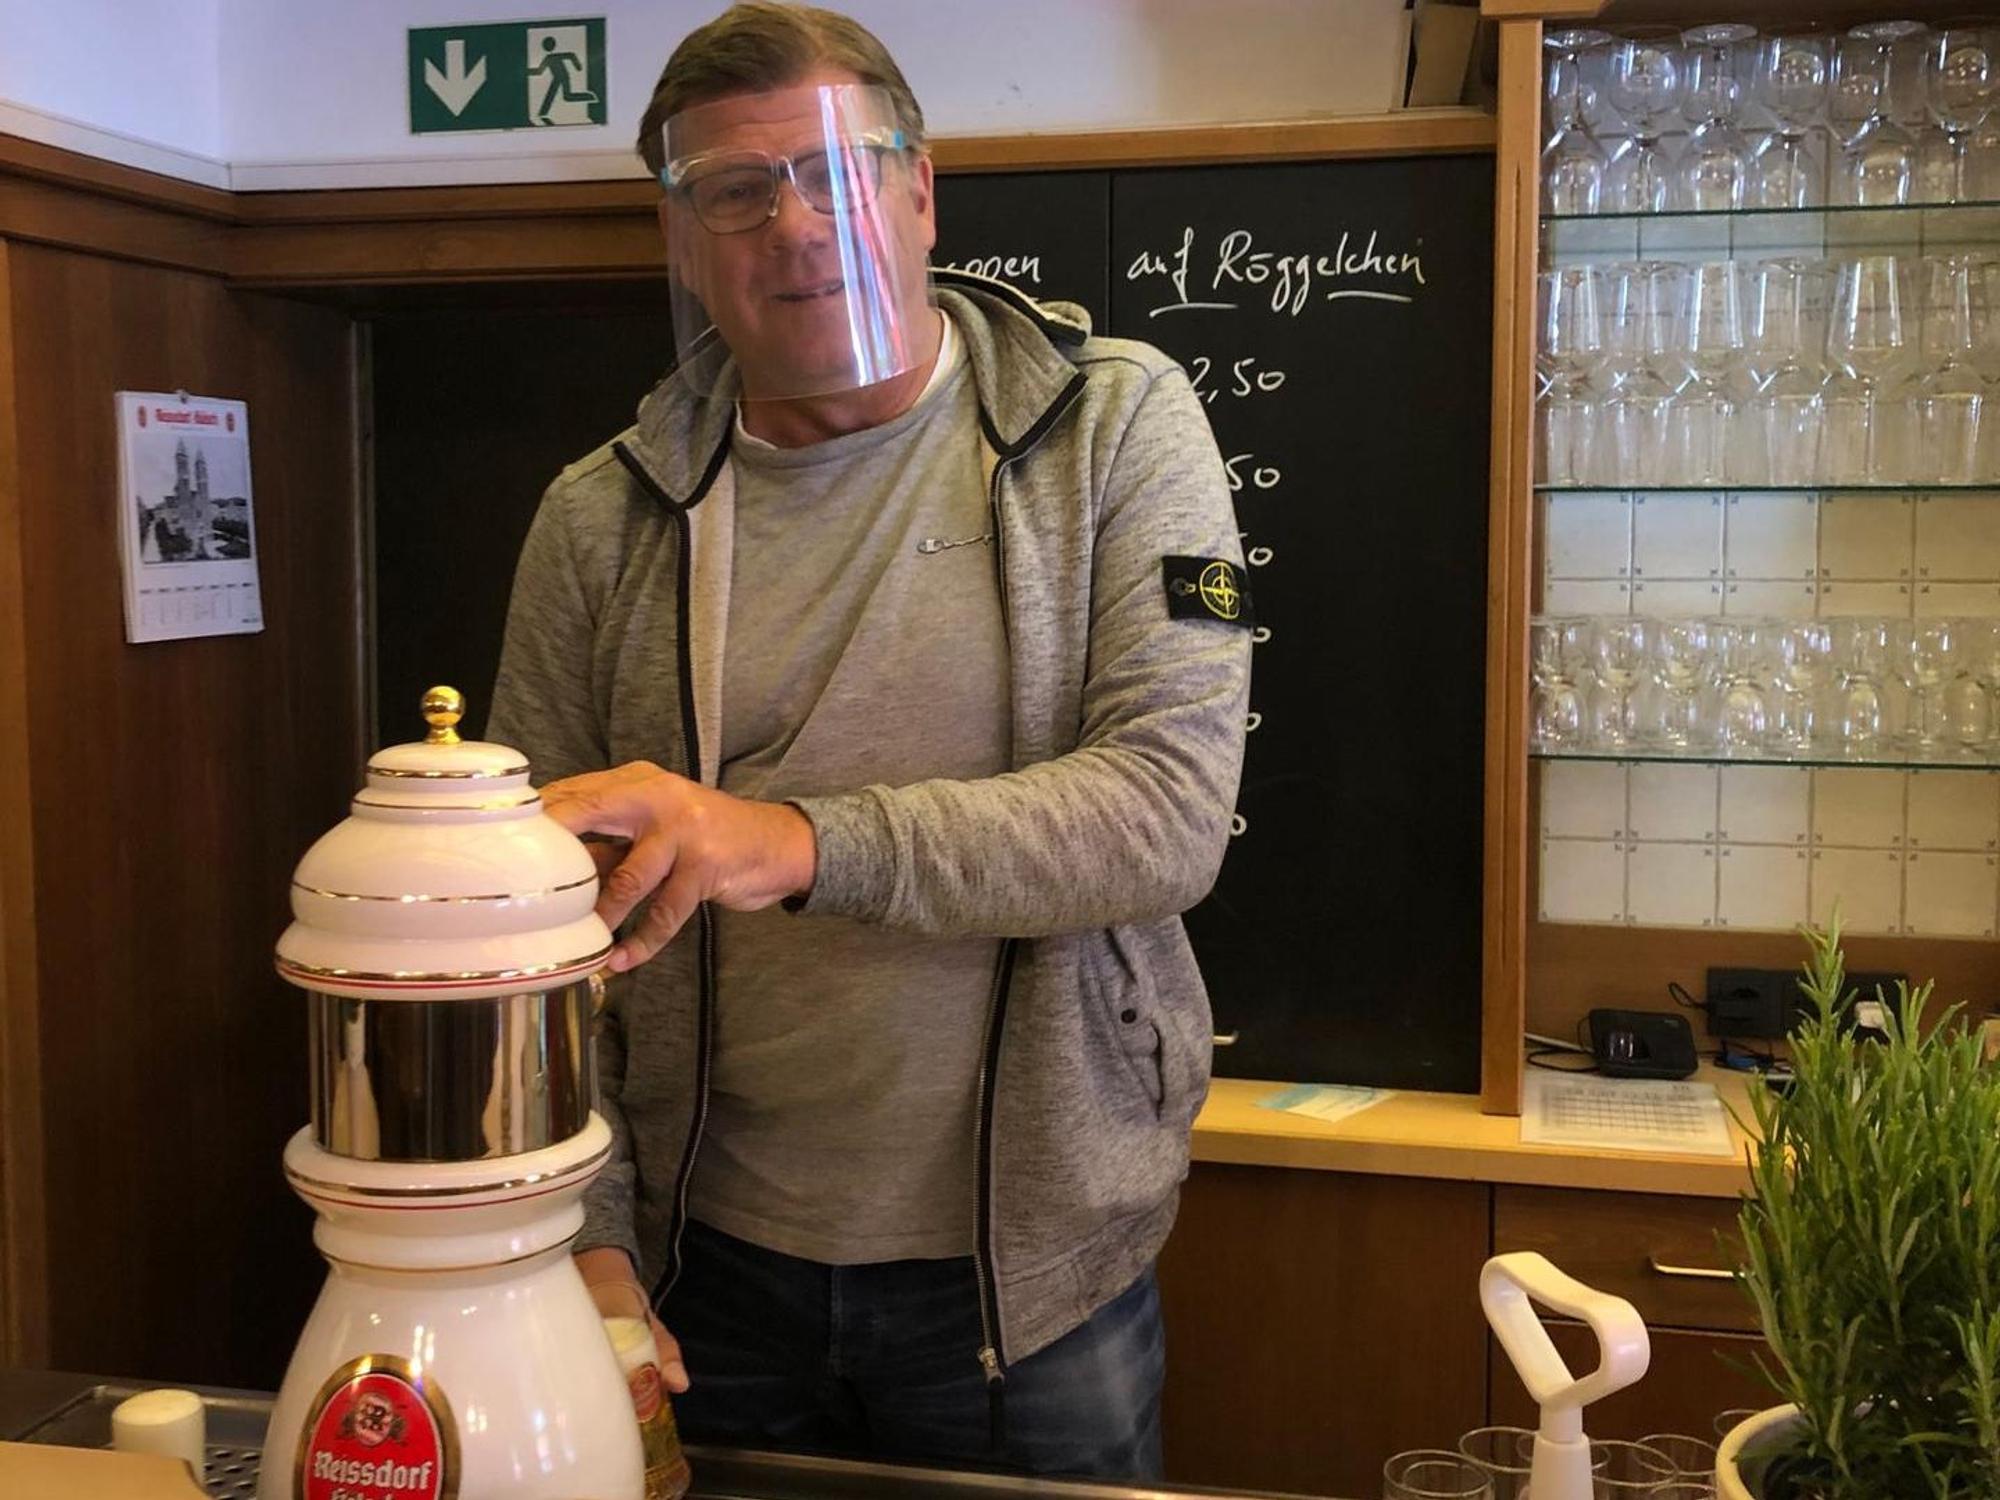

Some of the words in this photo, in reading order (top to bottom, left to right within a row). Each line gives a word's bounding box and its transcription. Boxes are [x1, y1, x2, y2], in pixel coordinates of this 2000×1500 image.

[1126, 226, 1195, 304] auf
[1192, 356, 1286, 403] 2,50
[314, 1450, 433, 1490] Reissdorf
